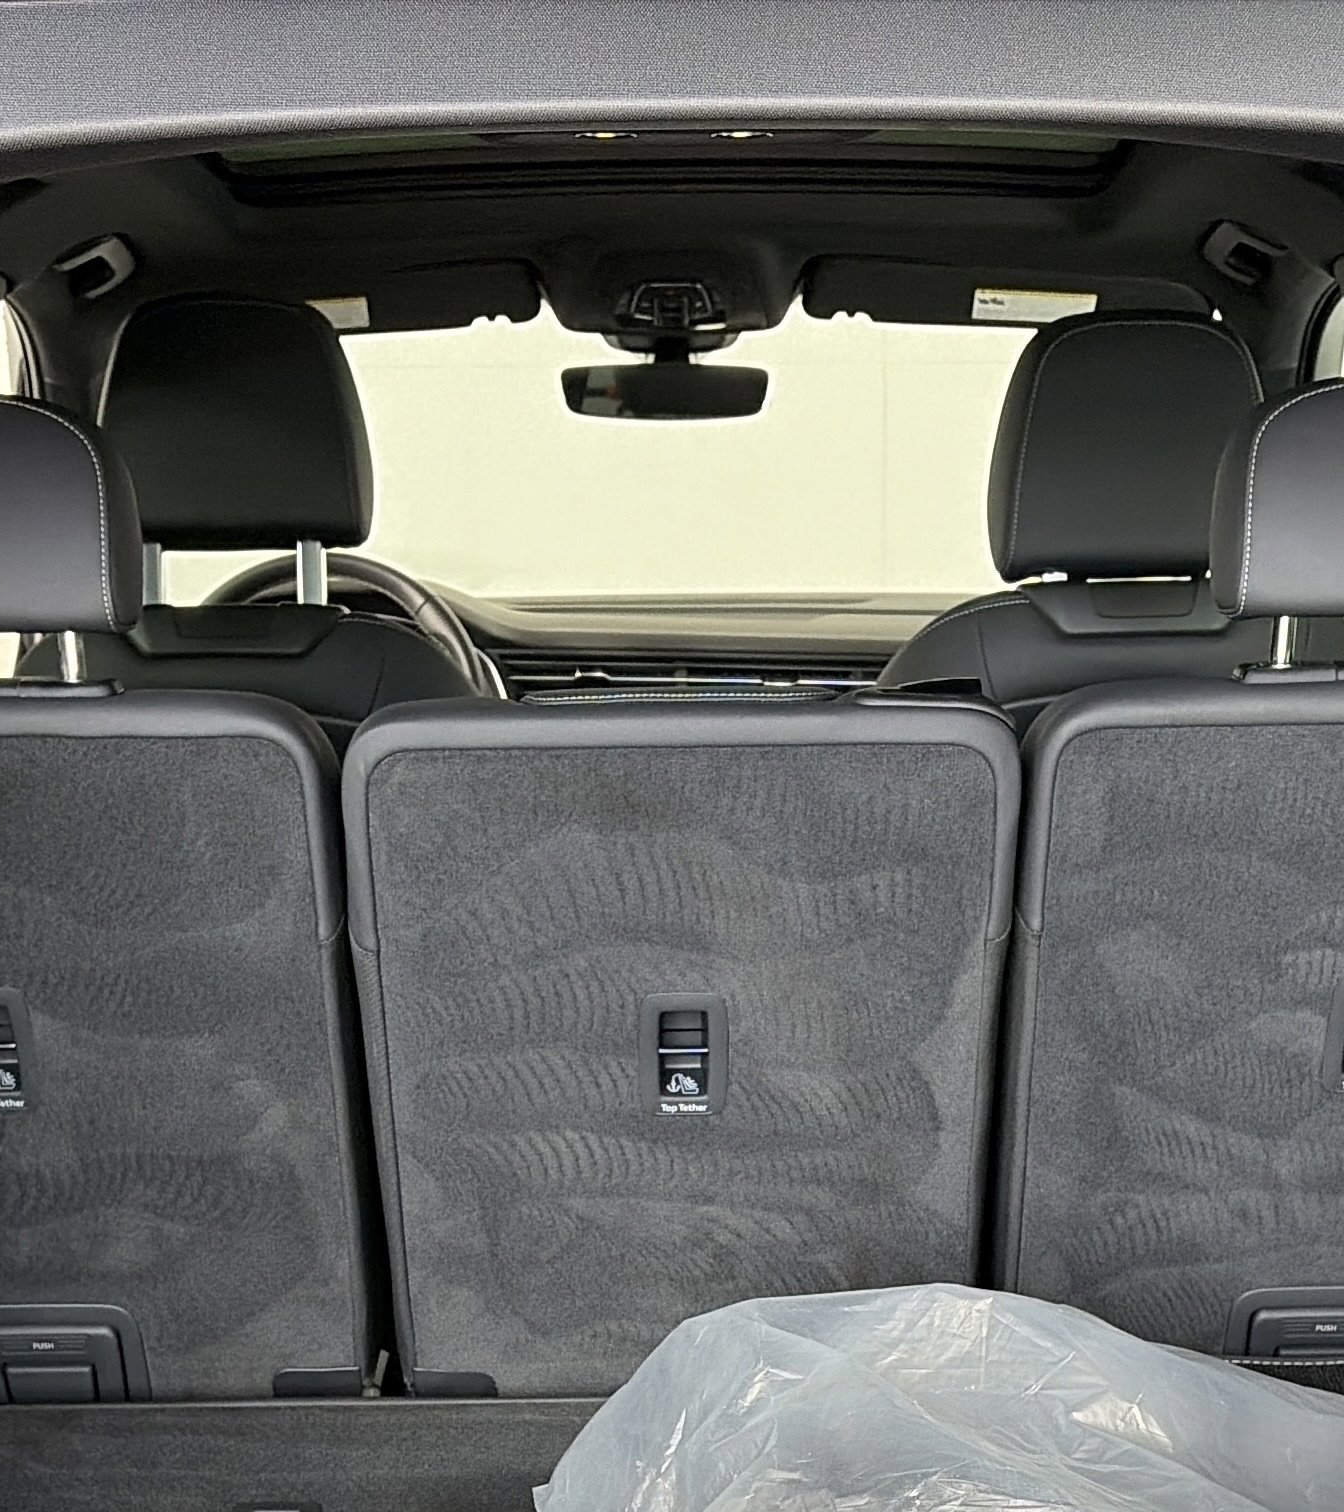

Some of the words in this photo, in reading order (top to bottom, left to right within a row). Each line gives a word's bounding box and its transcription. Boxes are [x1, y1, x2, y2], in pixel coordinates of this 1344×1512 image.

[661, 1103, 678, 1114] Top
[678, 1103, 708, 1112] Tether
[1314, 1324, 1338, 1333] PUSH
[32, 1341, 55, 1350] PUSH
